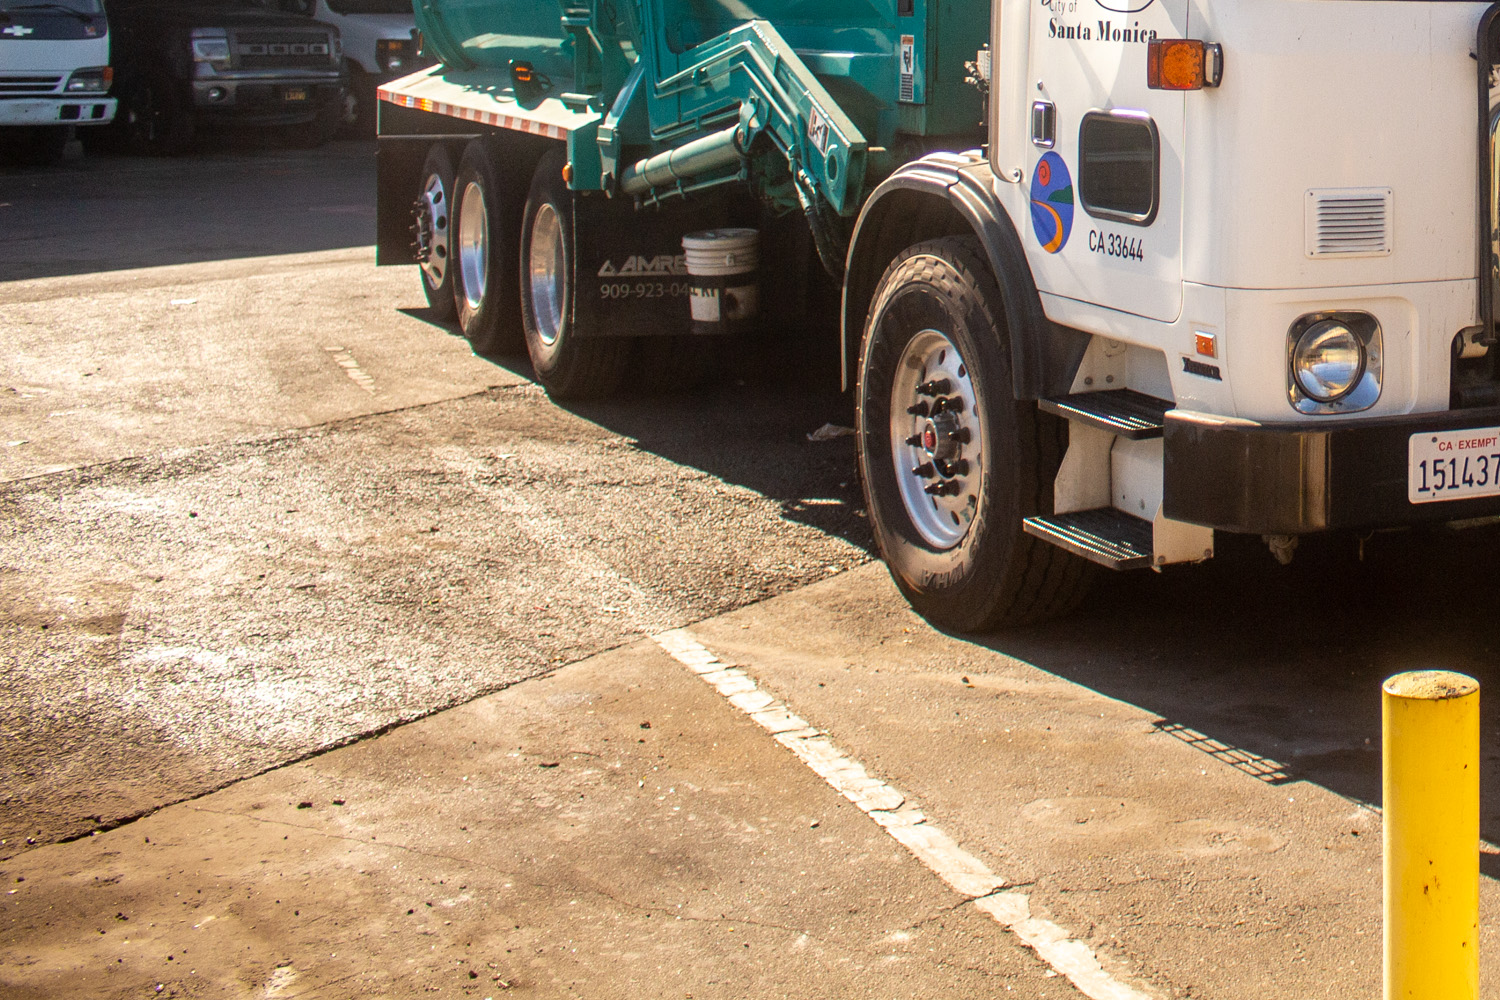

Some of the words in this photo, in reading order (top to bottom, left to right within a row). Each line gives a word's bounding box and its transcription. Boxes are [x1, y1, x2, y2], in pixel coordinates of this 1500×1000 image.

[1048, 17, 1091, 40] Santa
[1096, 20, 1157, 44] Monica
[1089, 229, 1105, 254] CA
[1108, 233, 1143, 262] 33644
[617, 255, 688, 276] AMRE
[600, 283, 689, 299] 909-923-04
[1438, 441, 1453, 451] CA
[1458, 437, 1498, 450] EXEMPT
